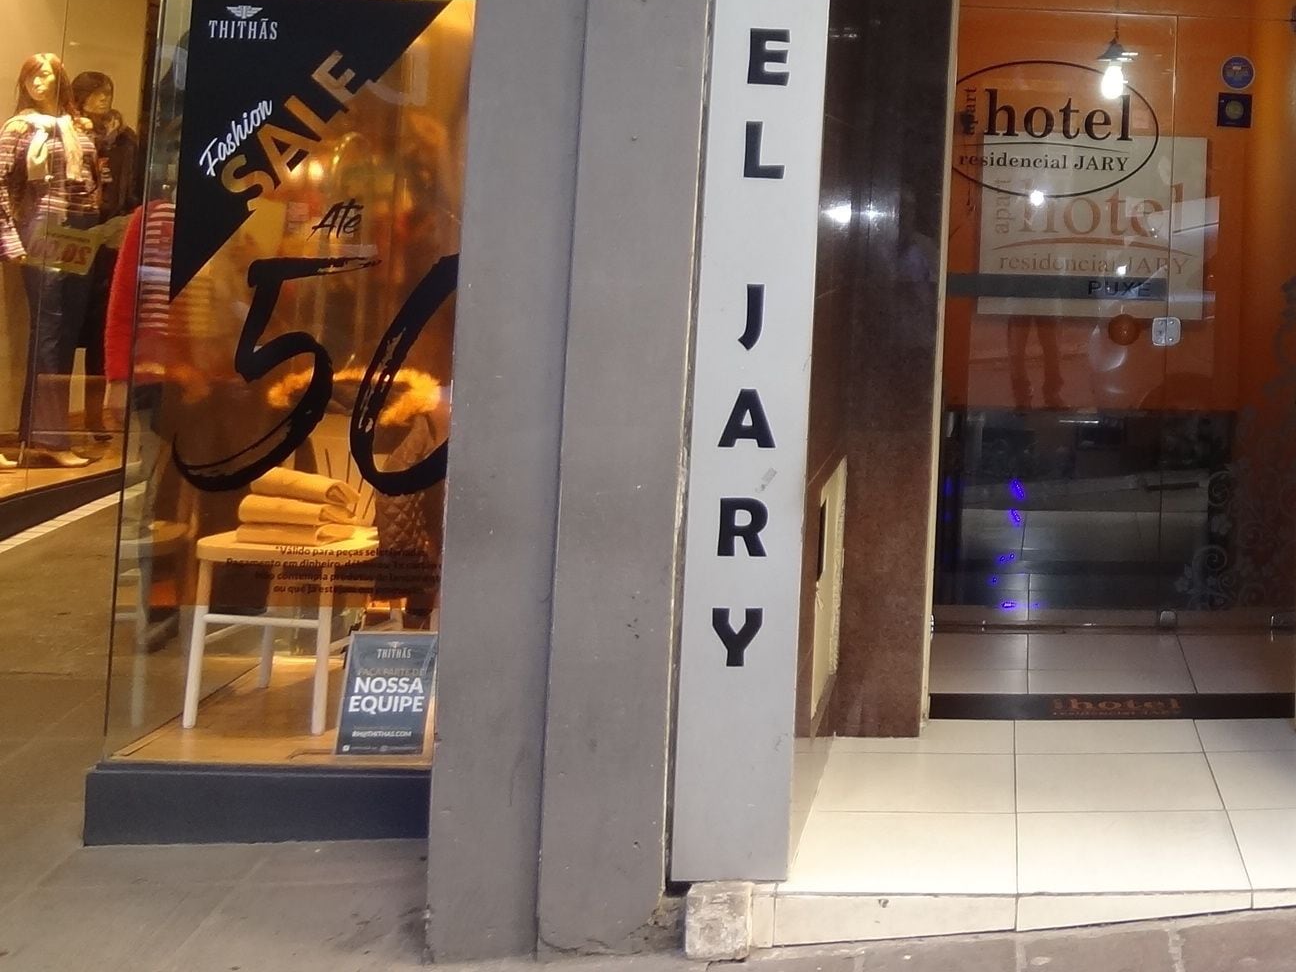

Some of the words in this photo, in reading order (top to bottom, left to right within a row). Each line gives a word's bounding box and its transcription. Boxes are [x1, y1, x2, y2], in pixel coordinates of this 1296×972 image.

[208, 17, 279, 40] THITHÃS
[983, 88, 1134, 142] hotel
[199, 100, 273, 177] Fashion
[220, 50, 361, 212] SALE
[958, 151, 1067, 171] residencial
[1073, 155, 1130, 172] JARY
[1087, 280, 1152, 297] PUXE
[711, 283, 777, 668] JARY
[354, 677, 424, 694] NOSSA
[348, 695, 425, 715] EQUIPE
